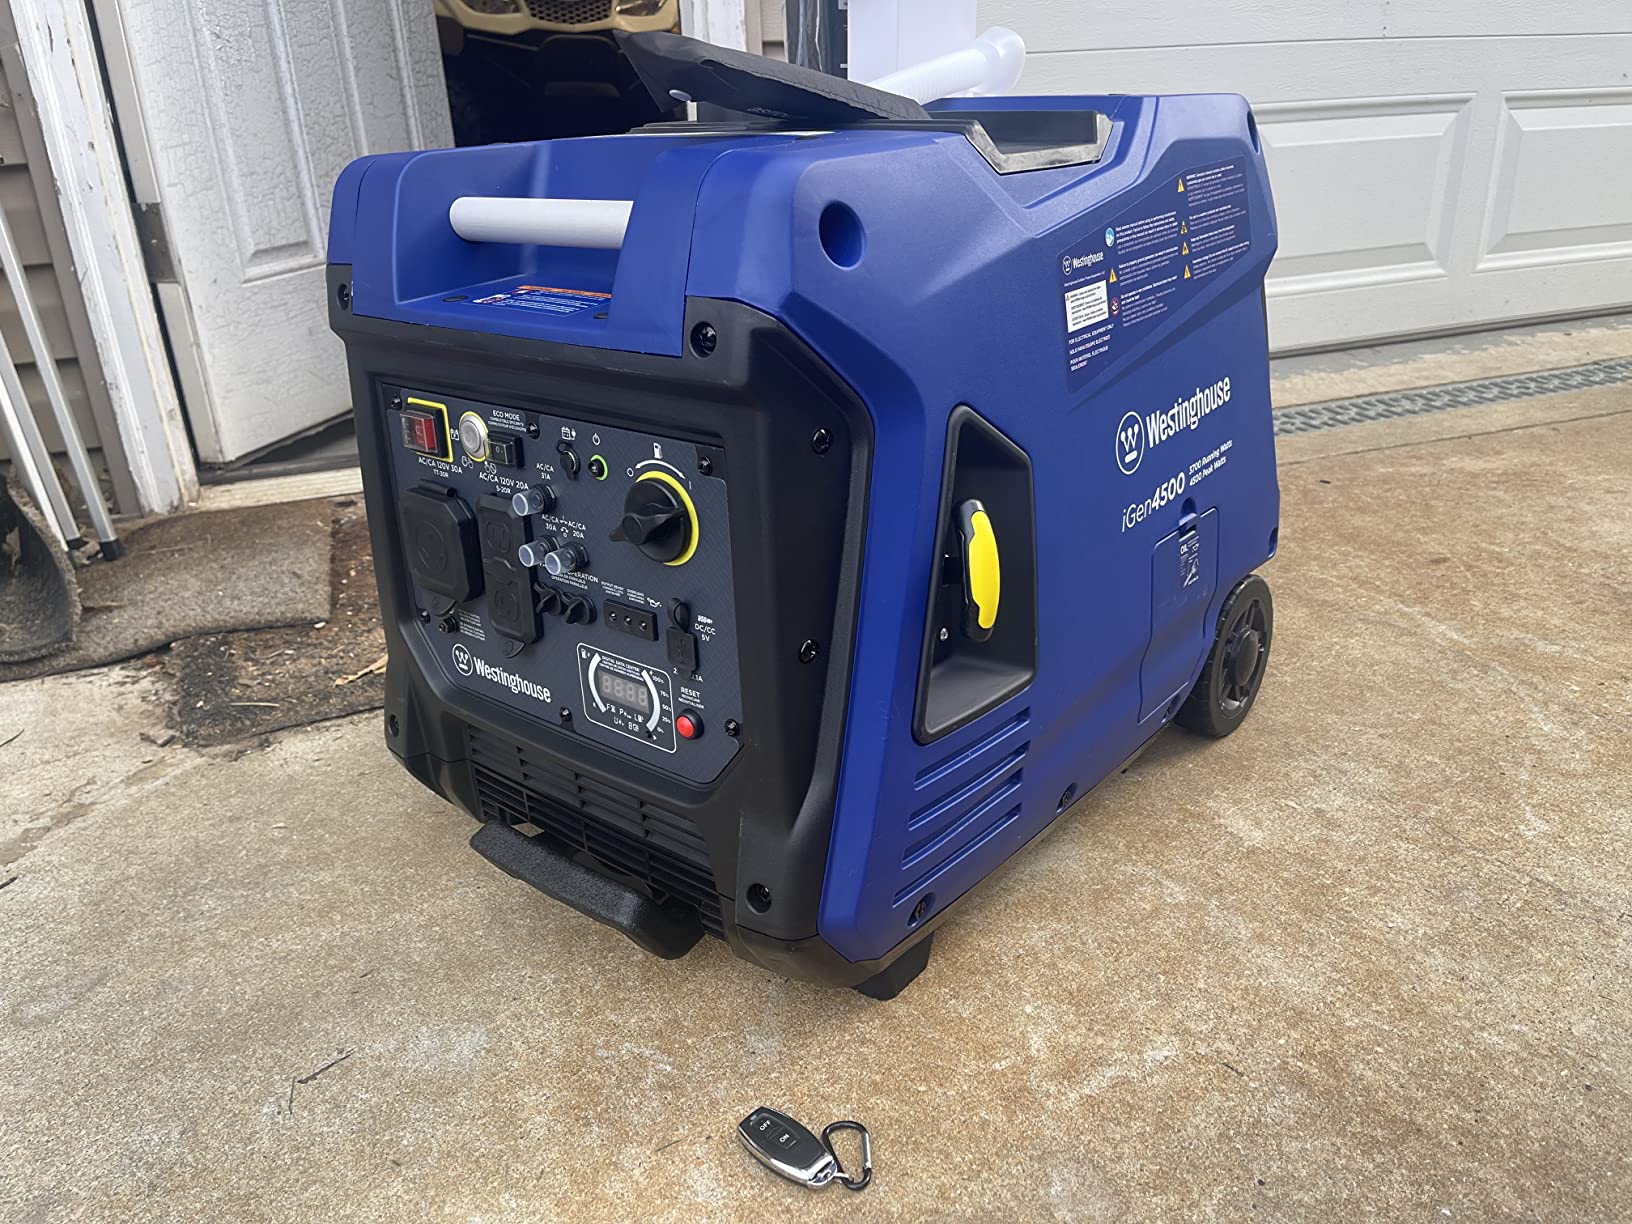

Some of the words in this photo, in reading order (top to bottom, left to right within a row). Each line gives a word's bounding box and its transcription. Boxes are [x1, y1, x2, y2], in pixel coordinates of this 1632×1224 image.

[1072, 251, 1104, 269] Westinghouse
[492, 409, 504, 418] ECO
[504, 412, 521, 421] MODE
[1145, 376, 1231, 448] Westinghouse
[1188, 459, 1202, 475] 3700
[1201, 448, 1220, 466] Running
[1220, 439, 1233, 453] Watts
[418, 456, 436, 468] AC/CA
[435, 461, 451, 471] 120V
[450, 463, 463, 474] 30A
[536, 462, 555, 473] AC/CA
[1189, 471, 1202, 486] 4500
[1202, 464, 1213, 478] Peak
[1213, 456, 1227, 470] Watts
[478, 470, 499, 484] AC/CA
[499, 476, 515, 487] 120V
[515, 480, 529, 490] 20A
[540, 472, 551, 480] 31A
[1121, 471, 1186, 533] iGen4500
[541, 513, 560, 524] AC/CA
[545, 522, 557, 532] 30A
[567, 520, 586, 531] AC/CA
[572, 530, 585, 539] 20A
[694, 623, 716, 635] DC/CC
[701, 634, 710, 642] 5V
[473, 656, 552, 703] Westinghouse
[680, 686, 701, 698] RESET
[759, 1119, 771, 1131] OFF
[779, 1133, 790, 1143] ON
